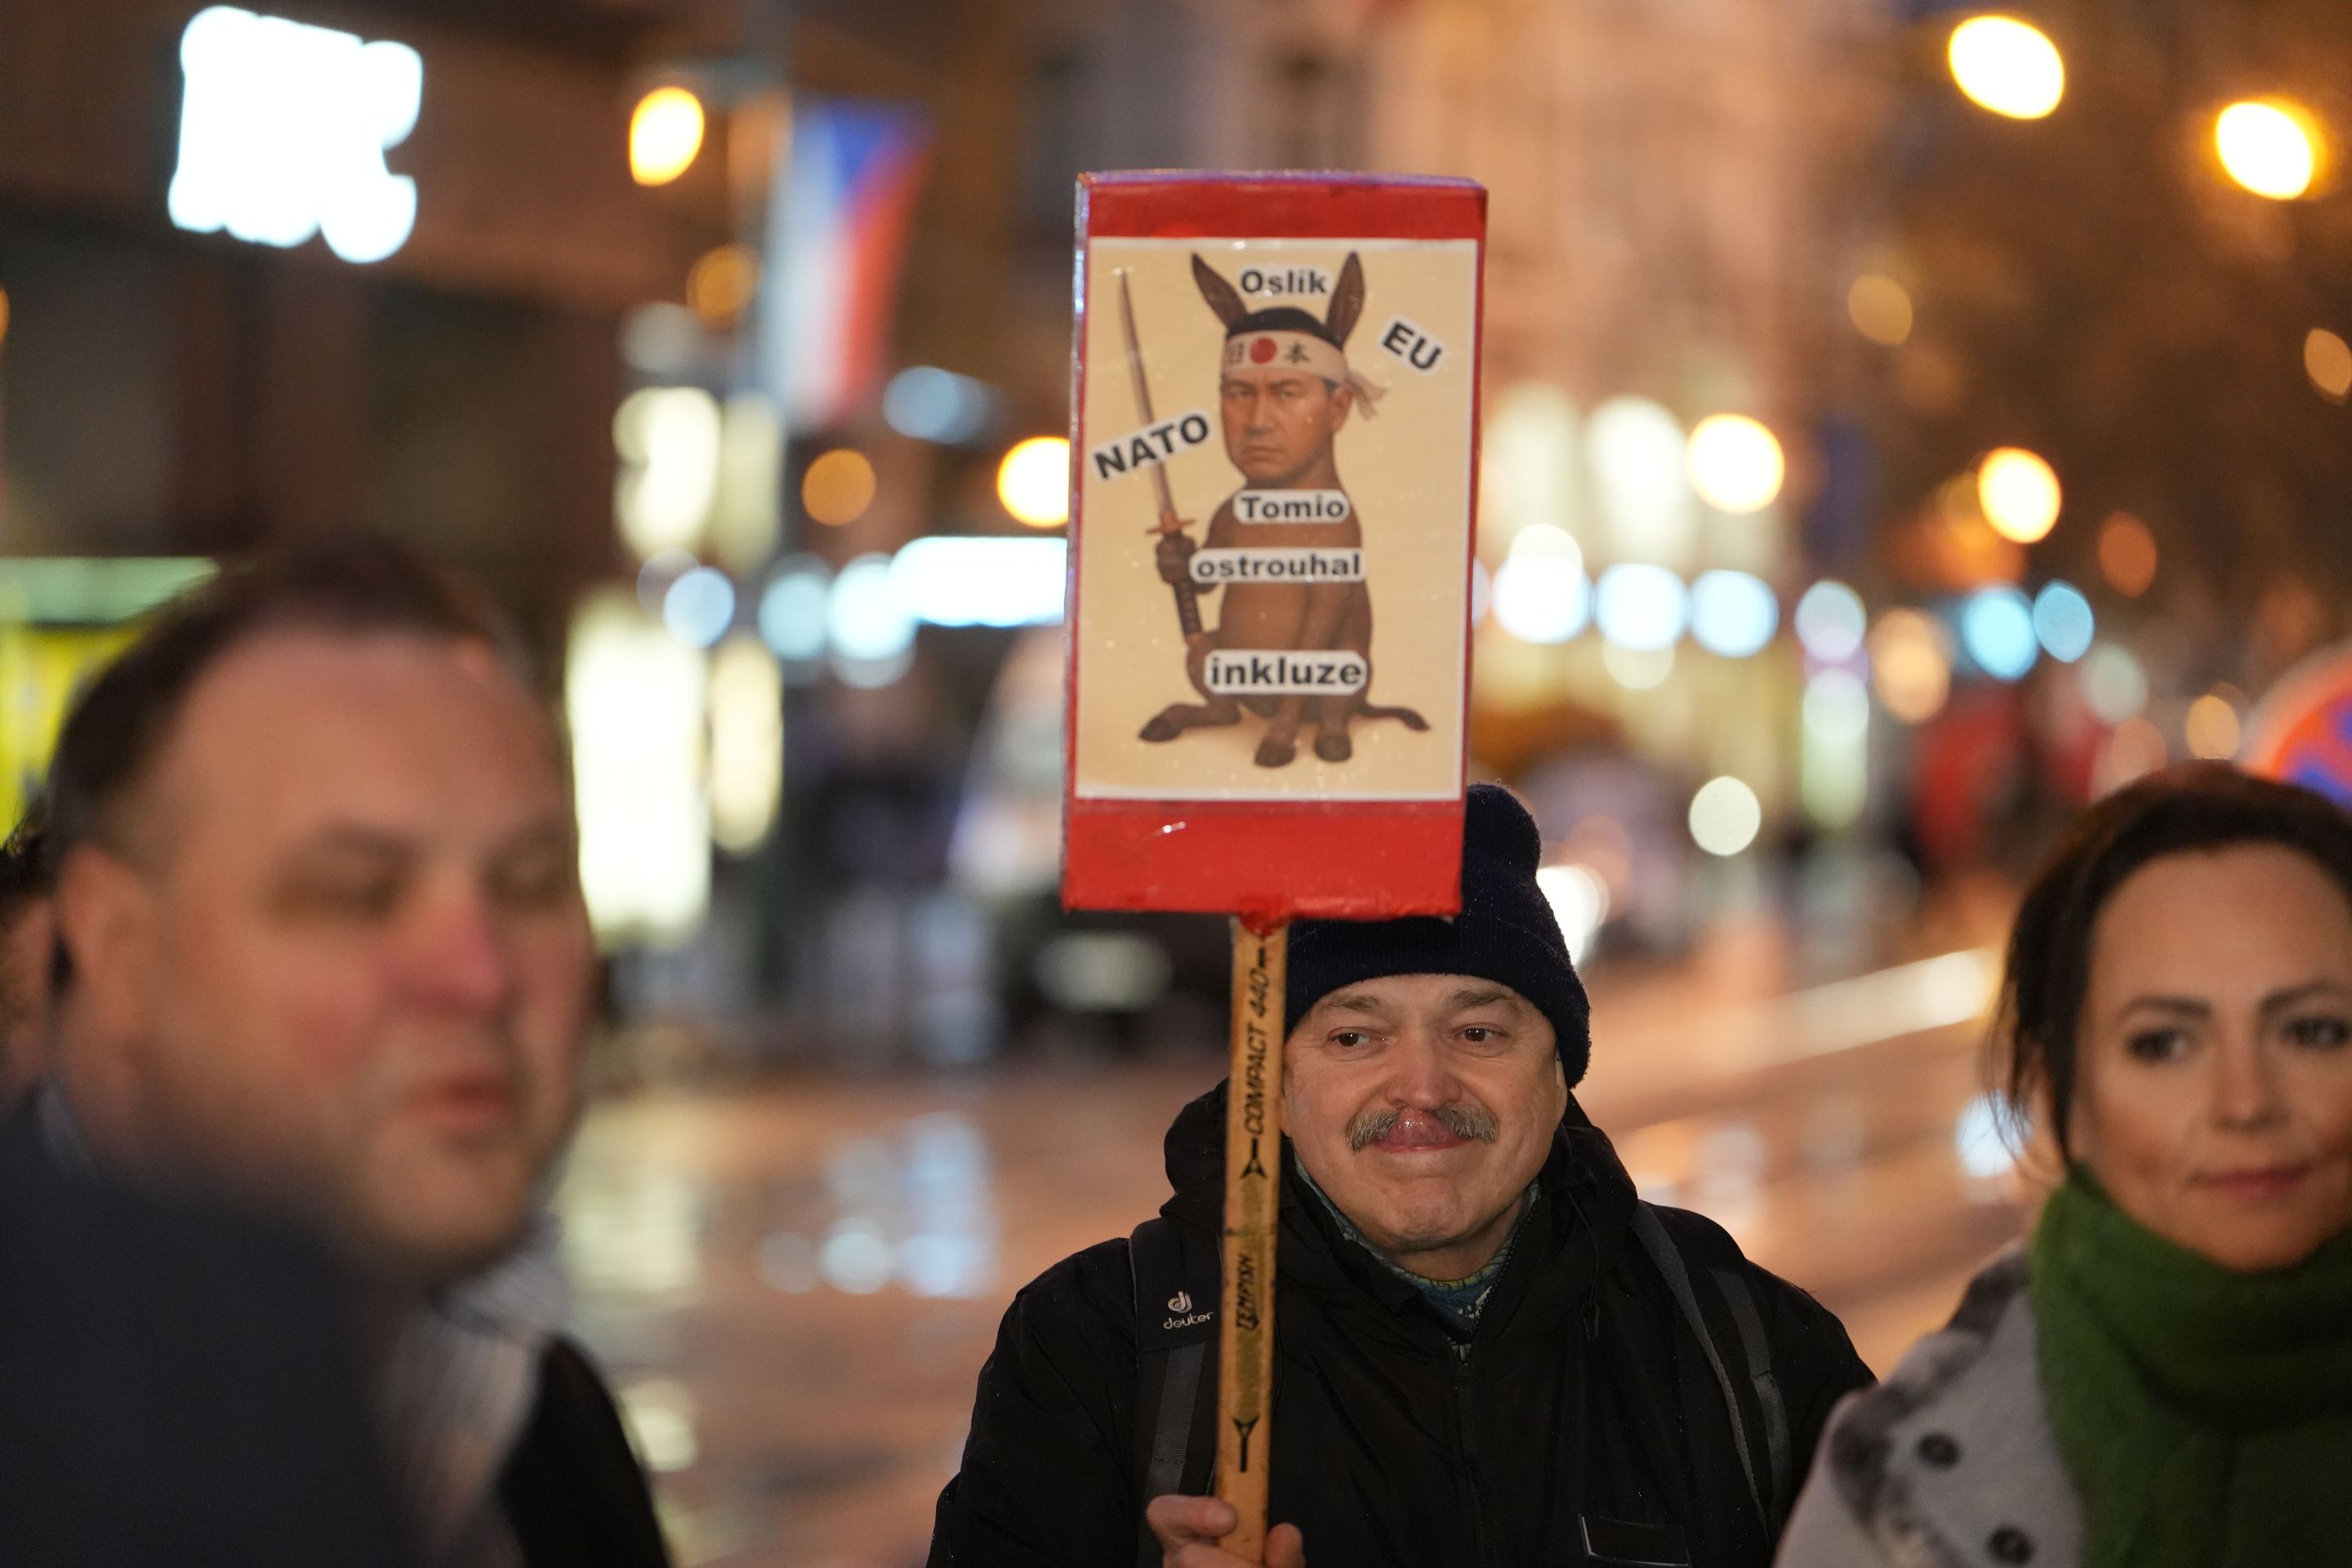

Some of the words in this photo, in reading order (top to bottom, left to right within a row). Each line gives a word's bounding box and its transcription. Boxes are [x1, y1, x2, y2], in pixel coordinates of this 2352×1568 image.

[1382, 320, 1443, 371] EU
[1094, 414, 1209, 479] NATO
[1241, 493, 1344, 519] Tomio
[1197, 554, 1360, 577] ostrouhal
[1210, 657, 1362, 685] inkluze
[1250, 968, 1269, 1018] 440
[1245, 1022, 1267, 1135] COMPACT
[1163, 1312, 1214, 1330] deuter
